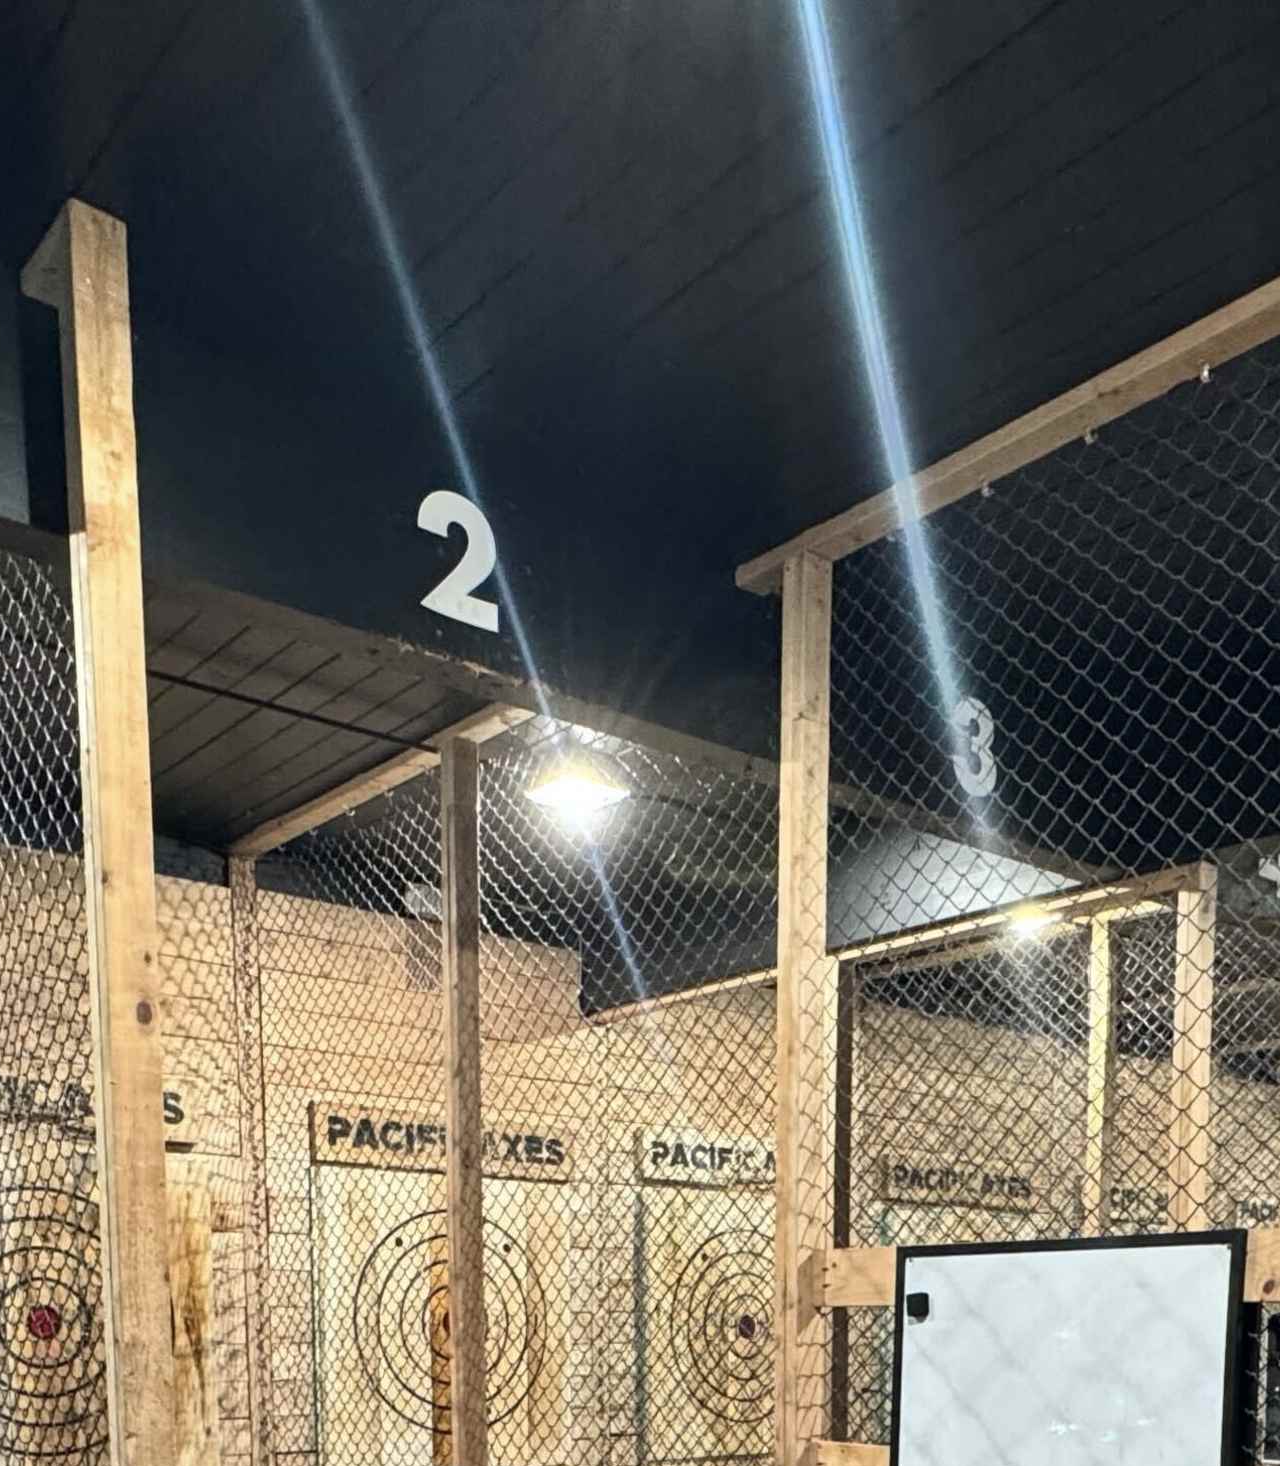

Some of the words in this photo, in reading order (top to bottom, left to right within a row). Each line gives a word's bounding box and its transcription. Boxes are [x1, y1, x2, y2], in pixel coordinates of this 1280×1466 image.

[417, 490, 498, 633] 2
[951, 696, 997, 797] 3
[327, 1115, 448, 1157] PACIFI
